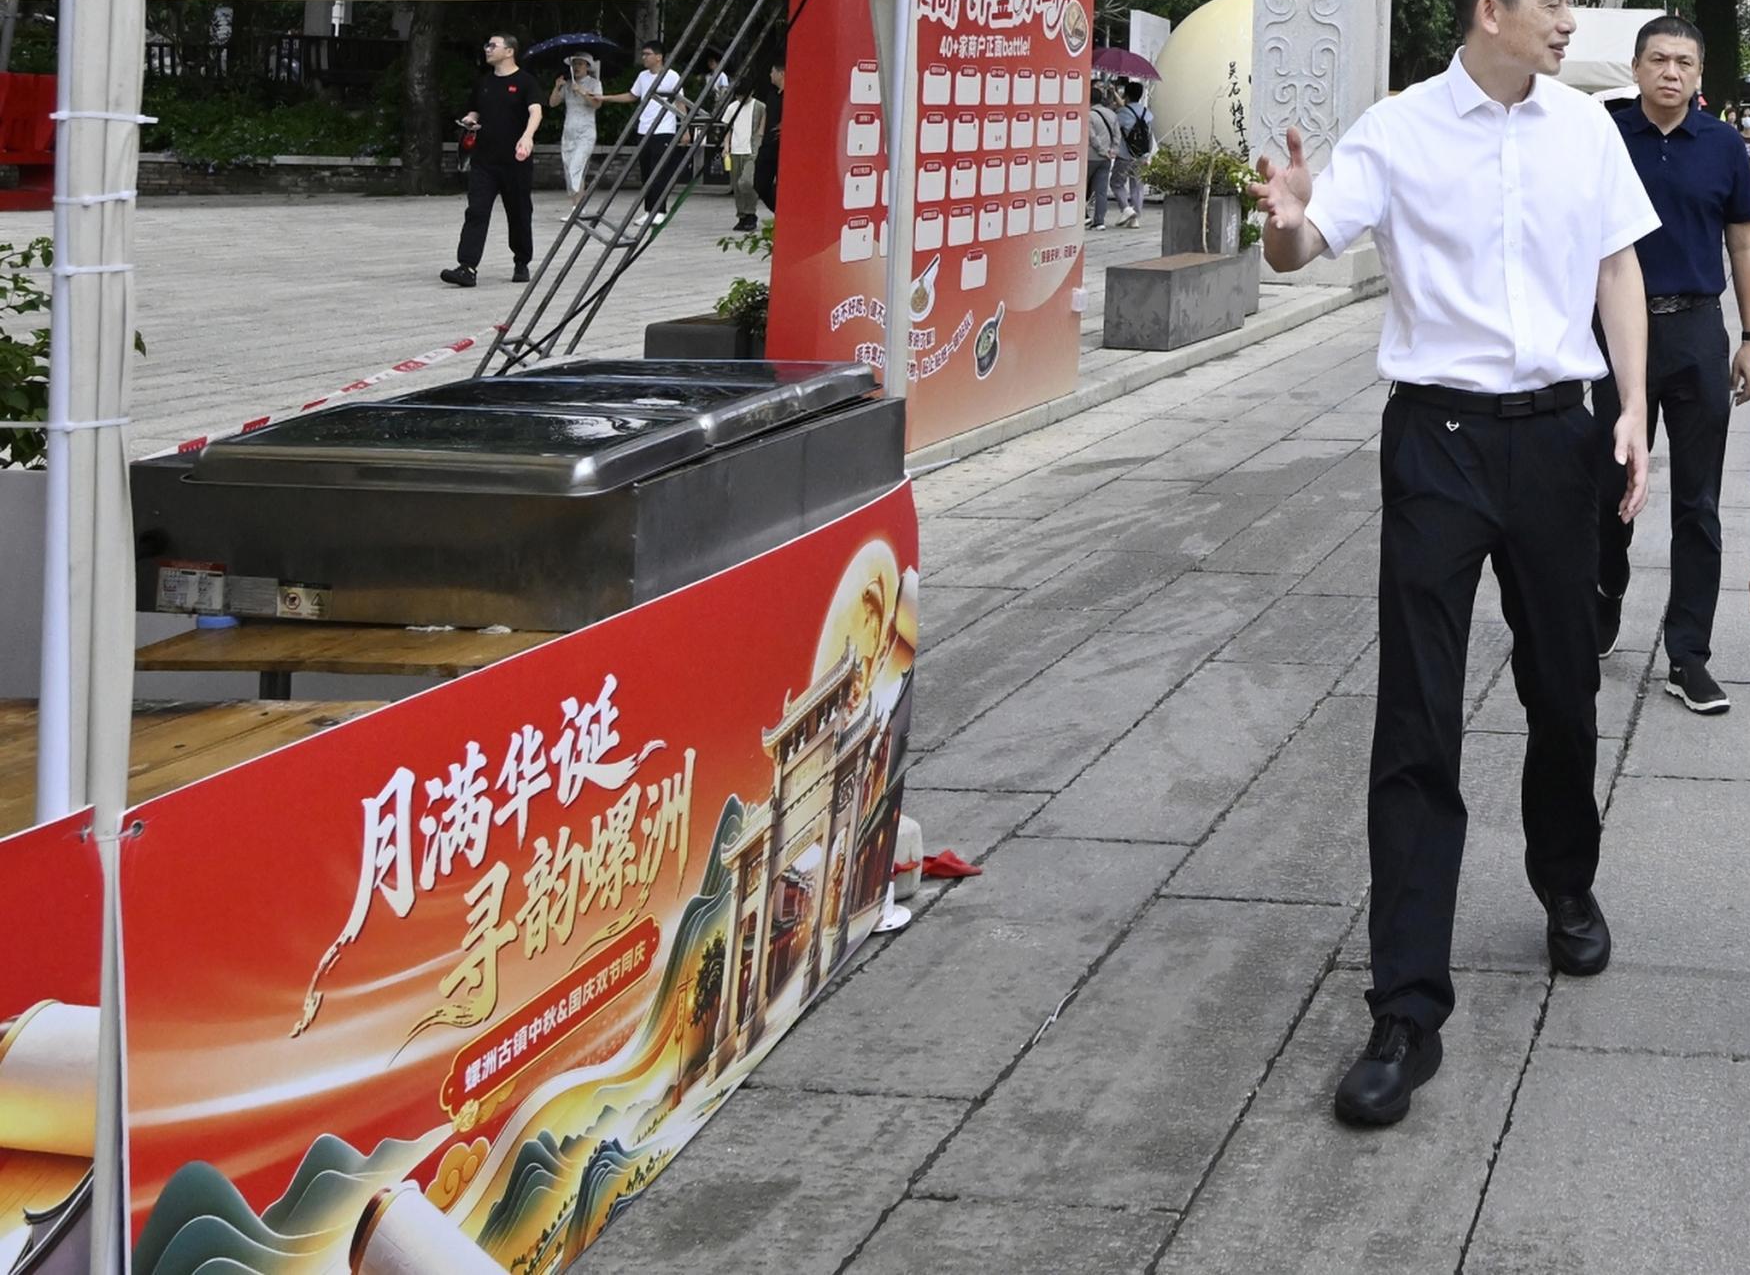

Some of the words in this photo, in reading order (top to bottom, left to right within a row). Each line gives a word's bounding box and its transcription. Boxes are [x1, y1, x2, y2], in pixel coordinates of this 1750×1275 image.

[290, 673, 667, 1037] 月满华诞
[405, 747, 697, 1031] 寻韵螺洲
[463, 939, 646, 1094] 螺洲古镇中秋&国庆双节同庆
